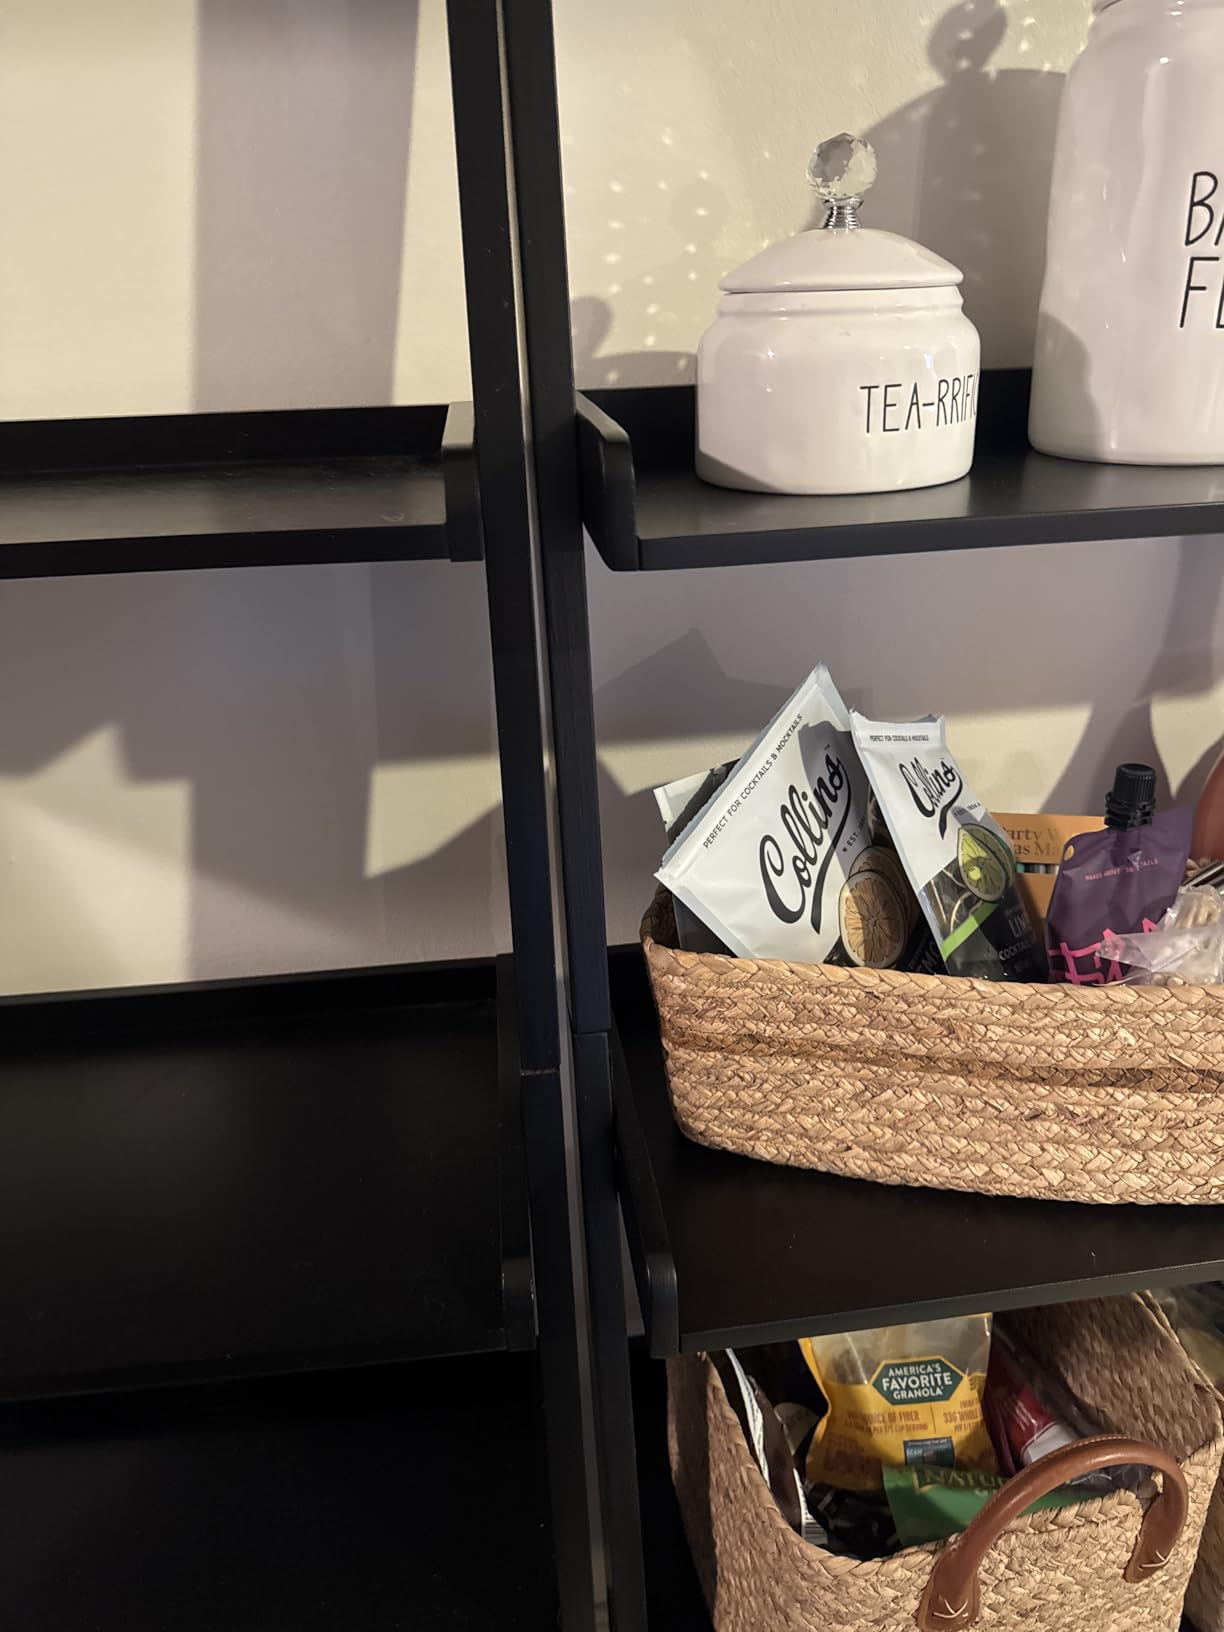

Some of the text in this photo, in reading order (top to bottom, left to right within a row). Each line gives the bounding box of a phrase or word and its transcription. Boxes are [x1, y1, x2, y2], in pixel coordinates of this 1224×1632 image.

[703, 815, 728, 849] PERFECT
[727, 799, 742, 817] FOR
[741, 759, 772, 800] COCKTAILS
[776, 714, 803, 754] MOCKTAILS
[899, 757, 963, 839] Collins
[759, 753, 851, 935] Collins
[882, 1372, 953, 1391] FAVORITE
[888, 1362, 942, 1377] AMERICA'S
